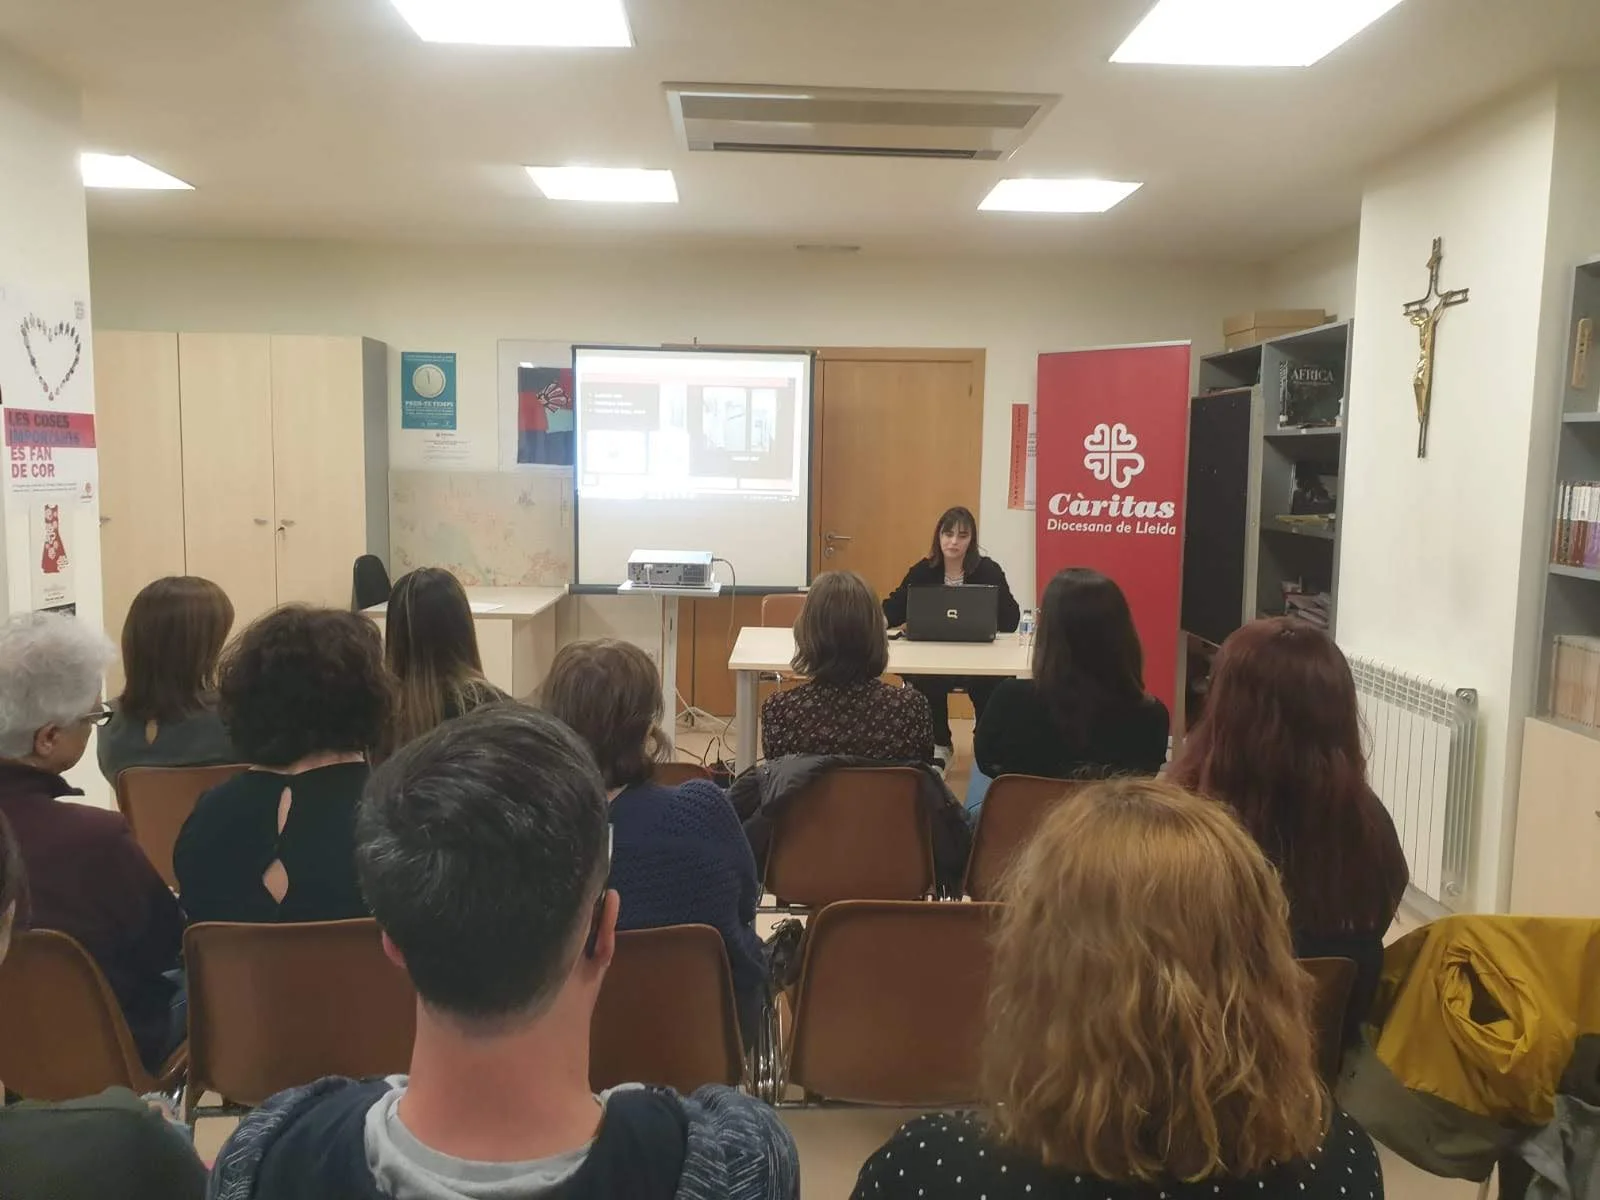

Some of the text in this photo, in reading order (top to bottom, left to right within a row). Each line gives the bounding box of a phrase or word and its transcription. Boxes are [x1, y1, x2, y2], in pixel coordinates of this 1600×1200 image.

[1290, 368, 1334, 381] AFRICA
[8, 411, 70, 429] LES COSES
[10, 446, 52, 461] ES FAN
[11, 463, 55, 478] DE COR
[1048, 493, 1175, 519] Càritas
[1047, 518, 1177, 536] Diocesana de Lleida
